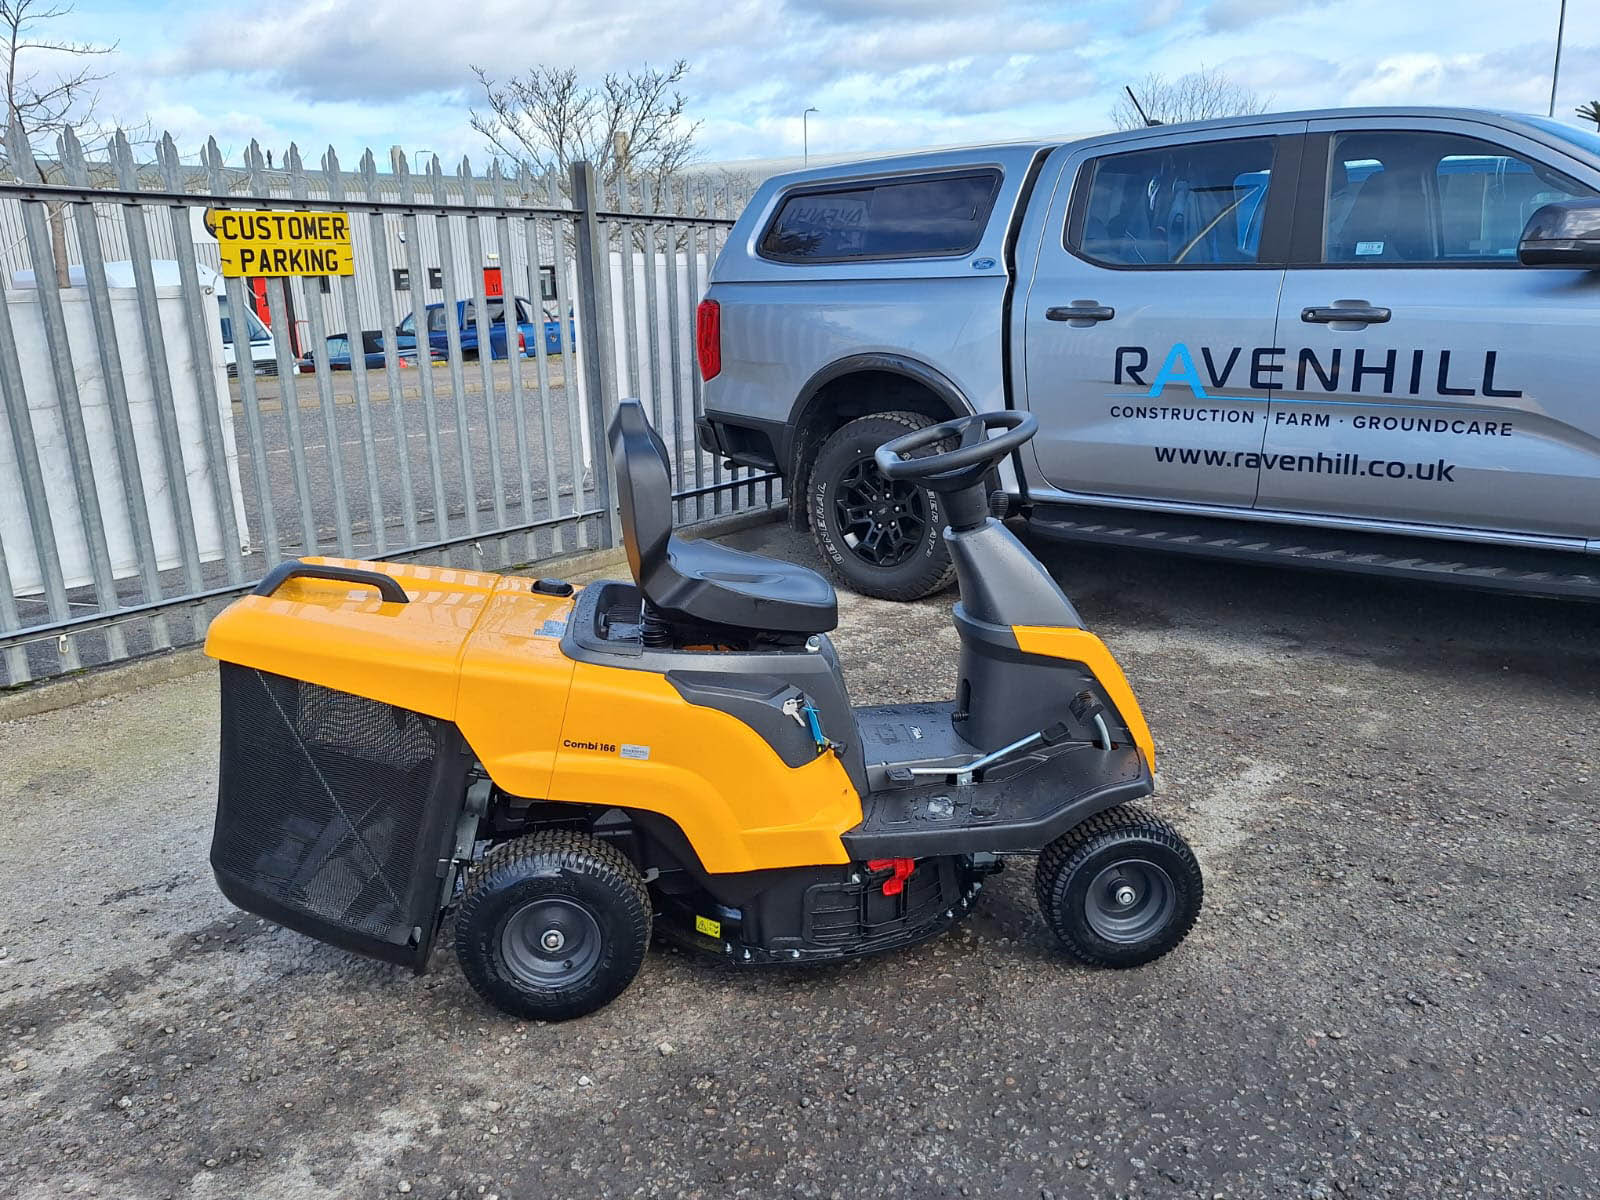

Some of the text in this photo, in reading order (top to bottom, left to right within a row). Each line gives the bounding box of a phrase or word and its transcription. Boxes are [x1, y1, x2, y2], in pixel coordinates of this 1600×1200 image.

[221, 215, 346, 240] CUSTOMER
[240, 248, 339, 273] PARKING
[1113, 342, 1522, 399] RAVENHILL
[1110, 405, 1513, 437] CONSTRUCTION FARM GROUNDCARE
[1154, 445, 1456, 482] www.ravenhill.co.uk
[815, 482, 845, 565] GENERAL
[563, 739, 598, 751] Combi
[600, 743, 616, 753] 166
